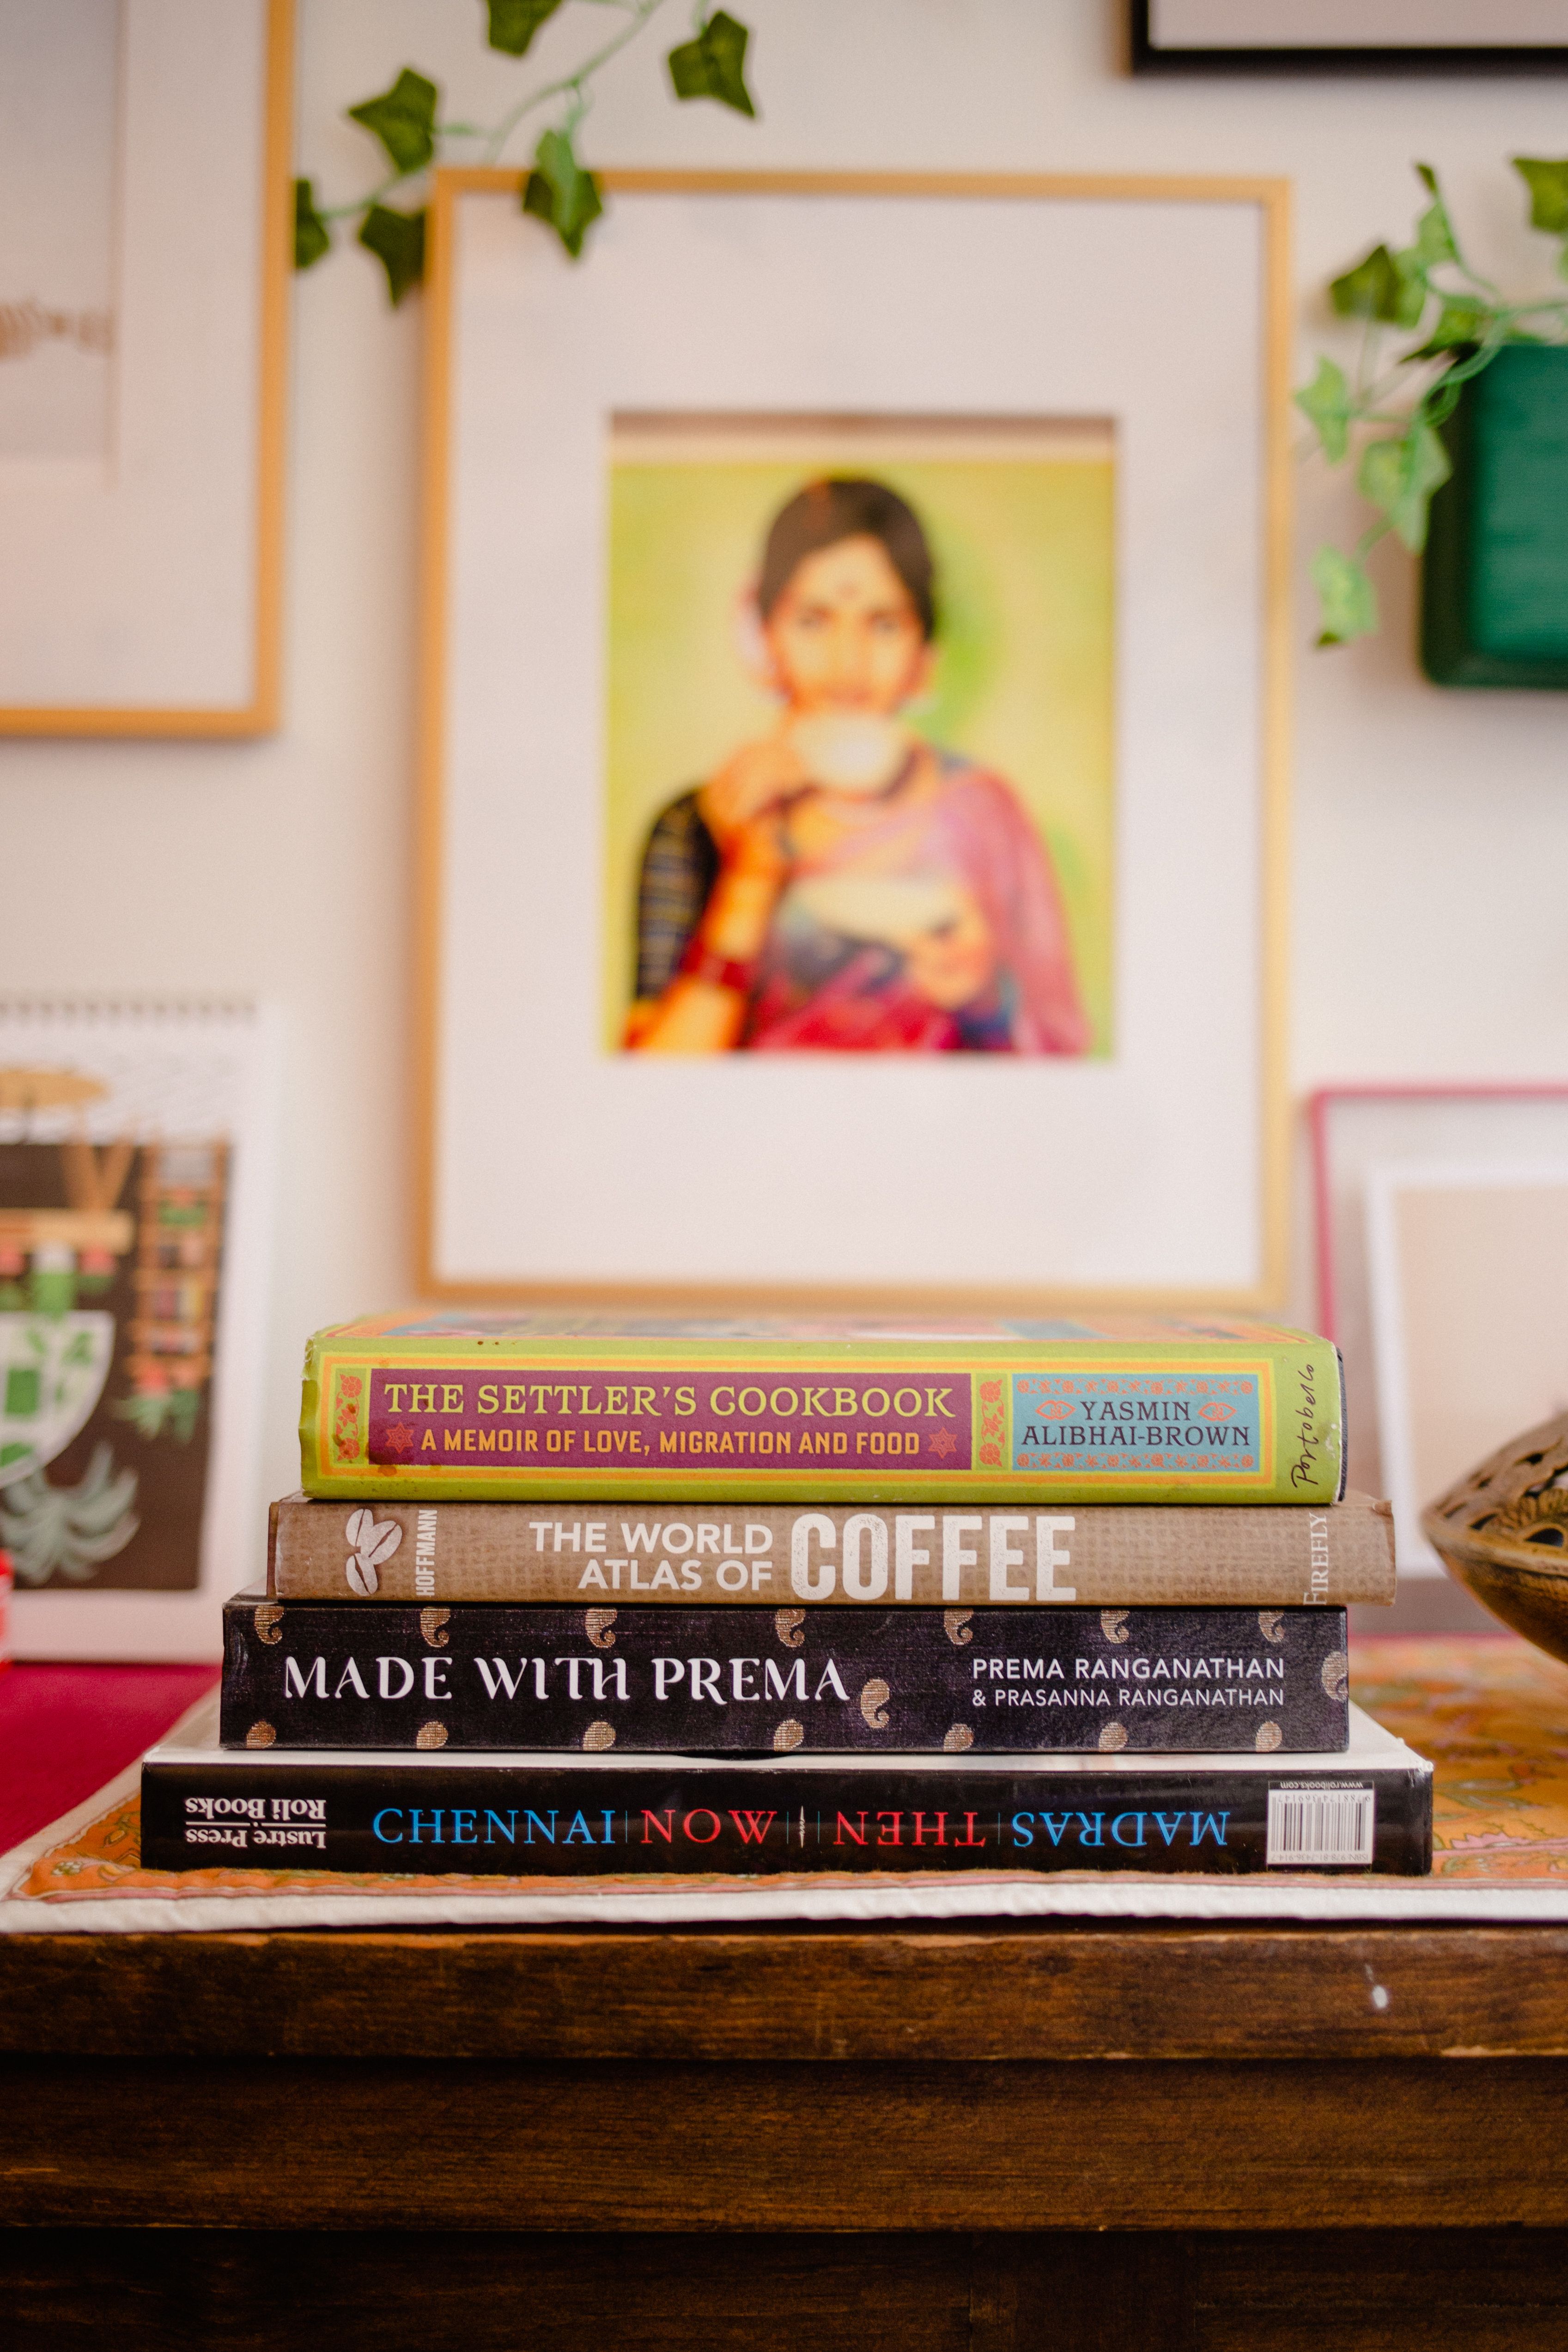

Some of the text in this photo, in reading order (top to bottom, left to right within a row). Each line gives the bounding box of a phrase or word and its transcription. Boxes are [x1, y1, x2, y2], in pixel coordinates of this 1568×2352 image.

[385, 1384, 955, 1417] THE SETTLER'S COOKBOOK
[1081, 1401, 1191, 1421] YASMIN
[1021, 1426, 1249, 1446] ALIBHAI-BROWN
[1291, 1364, 1319, 1488] Portobello
[421, 1429, 919, 1456] A MEMOIR OF LOVE, MIGRATION AND FOOD
[415, 1510, 437, 1597] HOFFMANN
[529, 1522, 772, 1554] THE WORLD
[791, 1513, 1076, 1601] COFFEE
[1303, 1513, 1329, 1605] FIREFLY
[578, 1559, 772, 1591] ATLAS OF
[285, 1656, 850, 1705] MADE WITH PREMA
[973, 1658, 1283, 1679] PREMA RANGANATHAN
[972, 1689, 1283, 1707] & PRASANNA RANGANATHAN
[1280, 1781, 1363, 1790] www.rolibooks.com
[185, 1798, 326, 1821] Roli Books
[186, 1829, 326, 1848] Lustre Press
[373, 1808, 777, 1844] CHENNAI NOW
[833, 1811, 1230, 1847] MADRAS THEN
